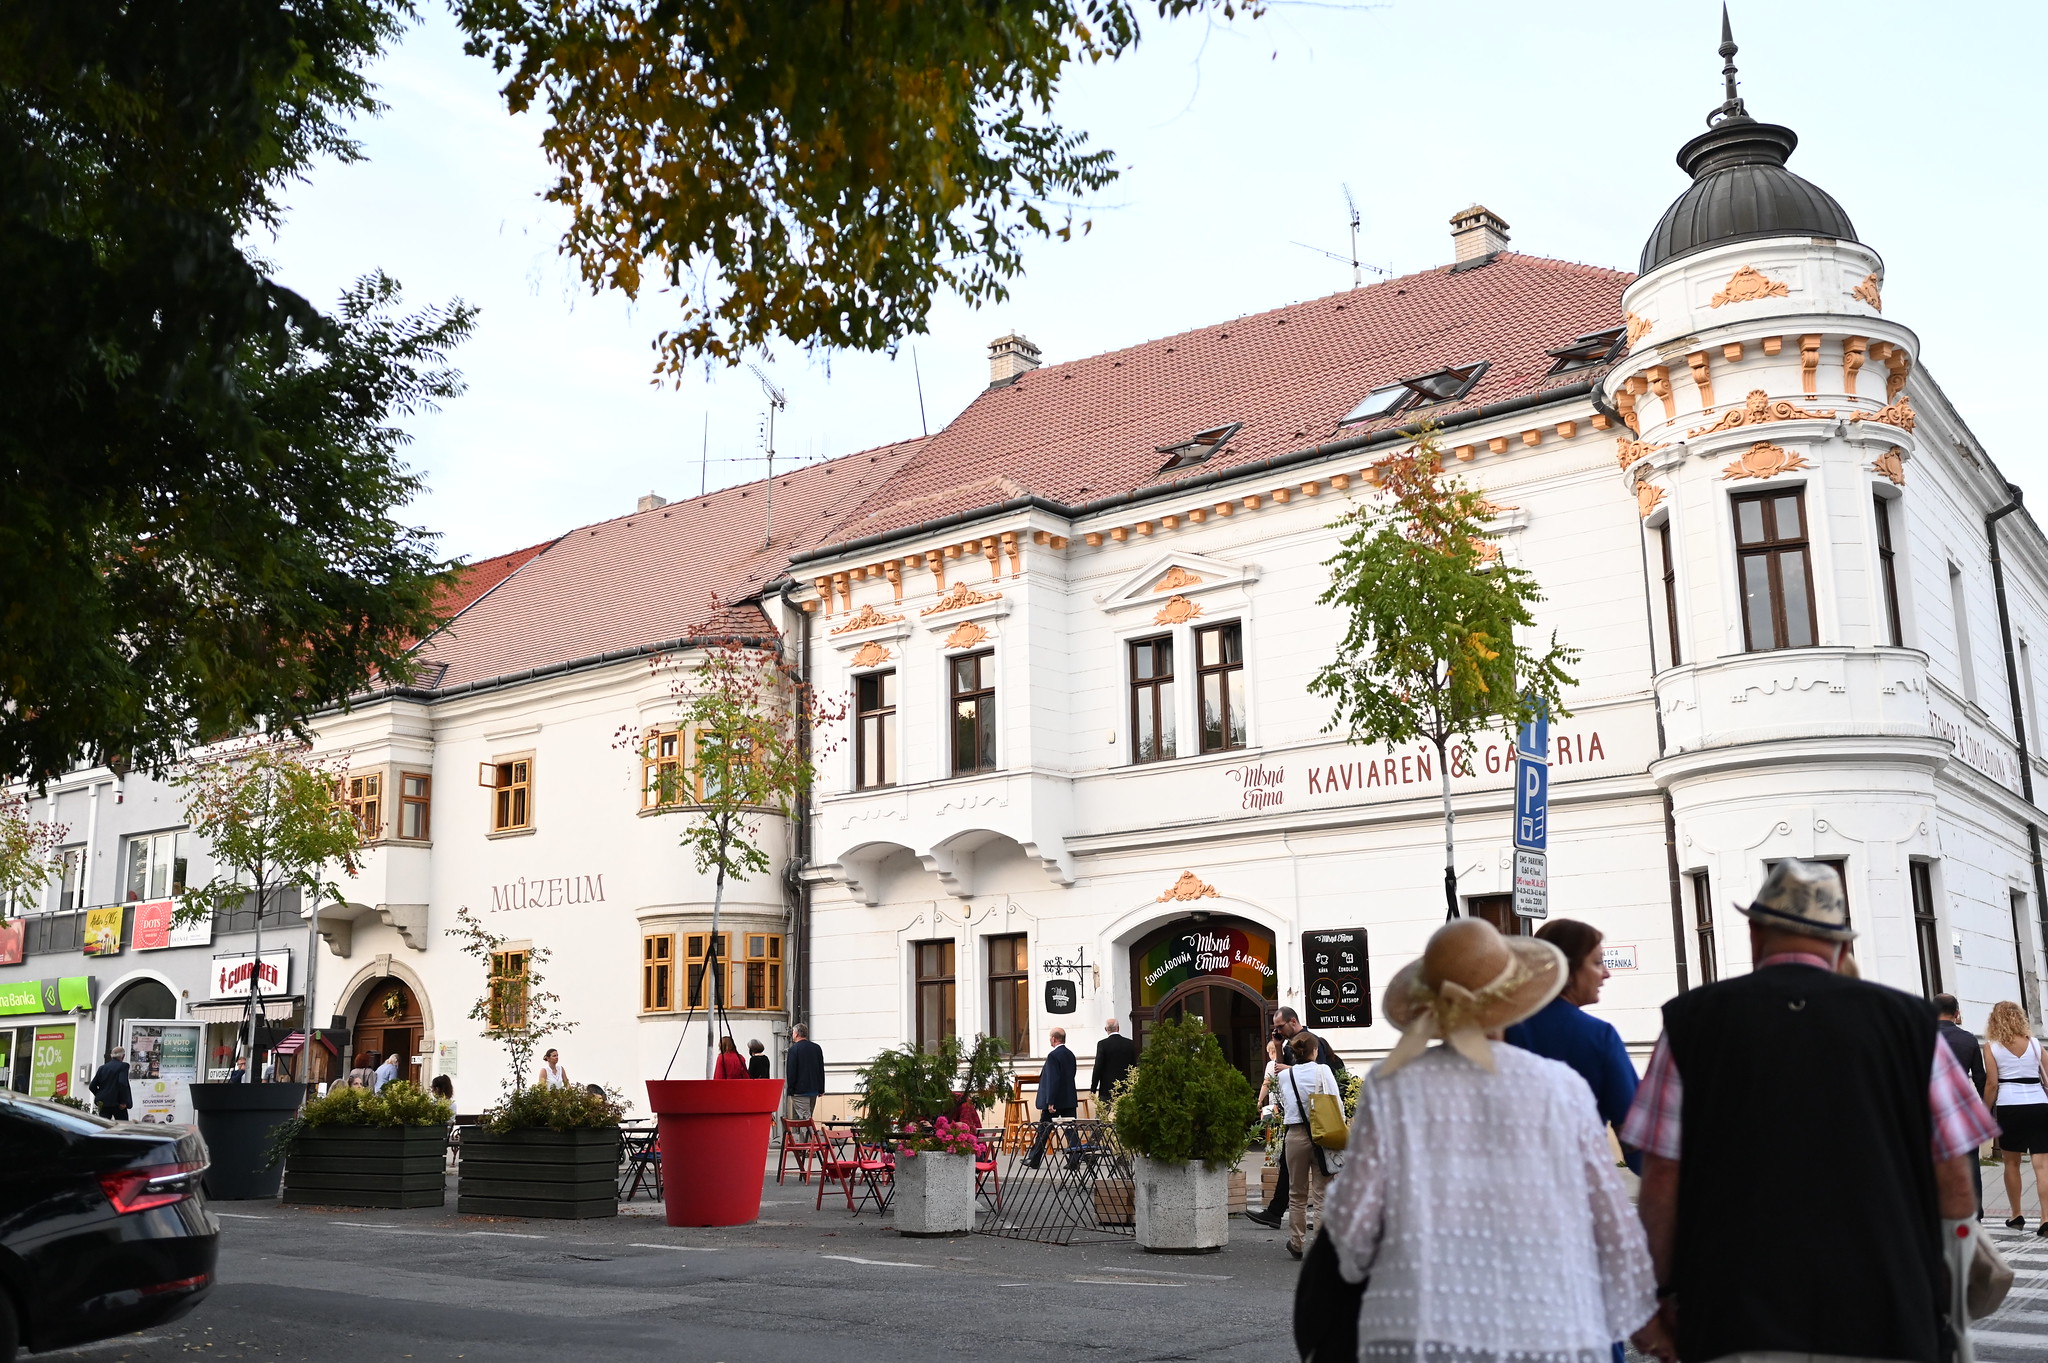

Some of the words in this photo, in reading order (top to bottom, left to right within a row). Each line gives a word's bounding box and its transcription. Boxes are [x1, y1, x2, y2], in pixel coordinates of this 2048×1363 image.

[1928, 709, 1956, 753] RTSHOP
[1957, 724, 1967, 758] &
[1308, 745, 1432, 794] KAVIAREŇ
[1450, 744, 1471, 778] &
[1486, 732, 1604, 774] GARIA
[1226, 763, 1284, 788] Mlsná
[1242, 788, 1284, 810] Emma
[1525, 766, 1540, 814] P
[1520, 856, 1528, 864] SMS
[1528, 857, 1544, 867] PARKING
[143, 918, 161, 928] DOTS
[1182, 932, 1230, 954] Mlsná
[1144, 950, 1192, 987] ČOKOLÁDOVŇA
[1194, 952, 1230, 972] Emma
[1234, 950, 1242, 962] &
[1241, 954, 1274, 978] ARTSHOP
[1603, 958, 1633, 969] TEFÁNIKA
[228, 962, 278, 990] CUKRREŇ
[9, 990, 36, 1006] Banka
[234, 985, 272, 994] HARÝN
[1346, 1014, 1356, 1022] NÁS
[210, 1070, 231, 1079] OTVORE
